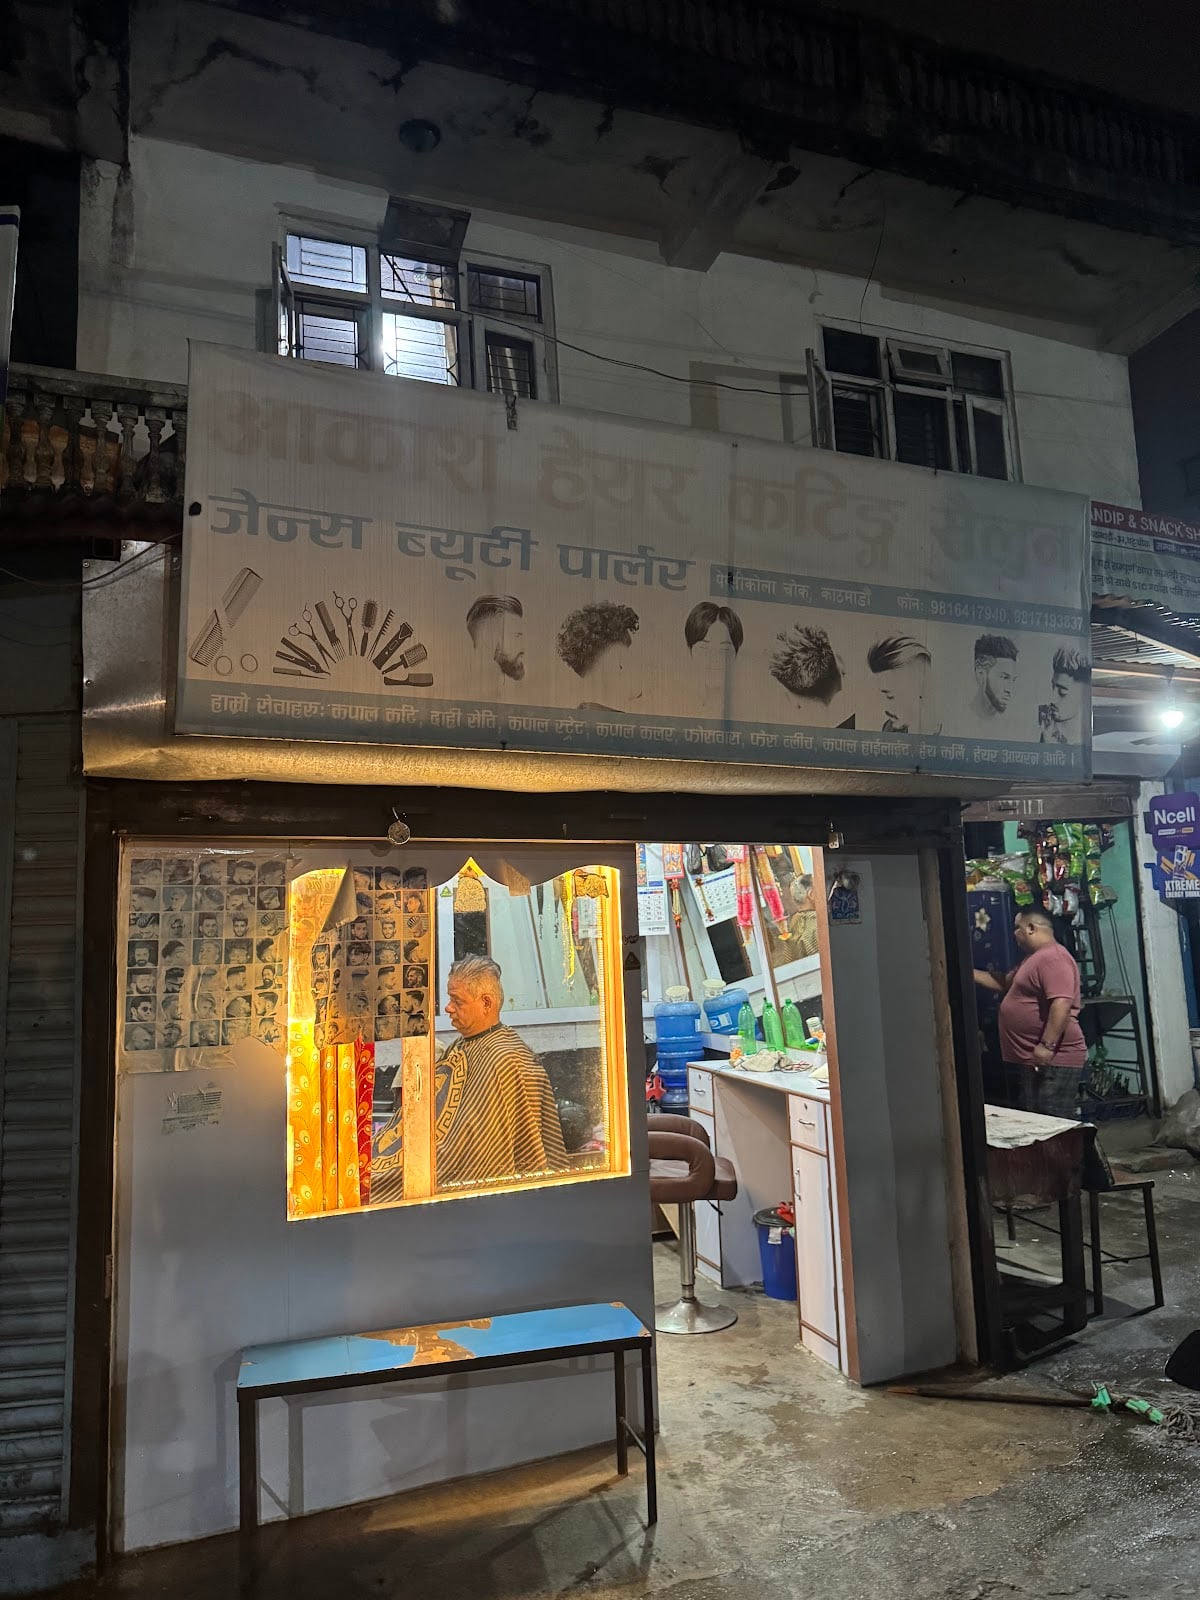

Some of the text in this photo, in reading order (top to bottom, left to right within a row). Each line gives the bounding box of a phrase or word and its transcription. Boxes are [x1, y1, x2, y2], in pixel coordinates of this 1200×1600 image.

[1091, 507, 1125, 525] NDIP
[1128, 514, 1137, 529] &
[208, 487, 373, 550] जेन्स
[557, 544, 697, 592] पार्लर
[330, 703, 380, 721] कपाल
[508, 716, 551, 733] कपाल
[596, 721, 636, 739] कपाल
[1154, 806, 1196, 826] Ncell
[1164, 879, 1200, 891] XTREME
